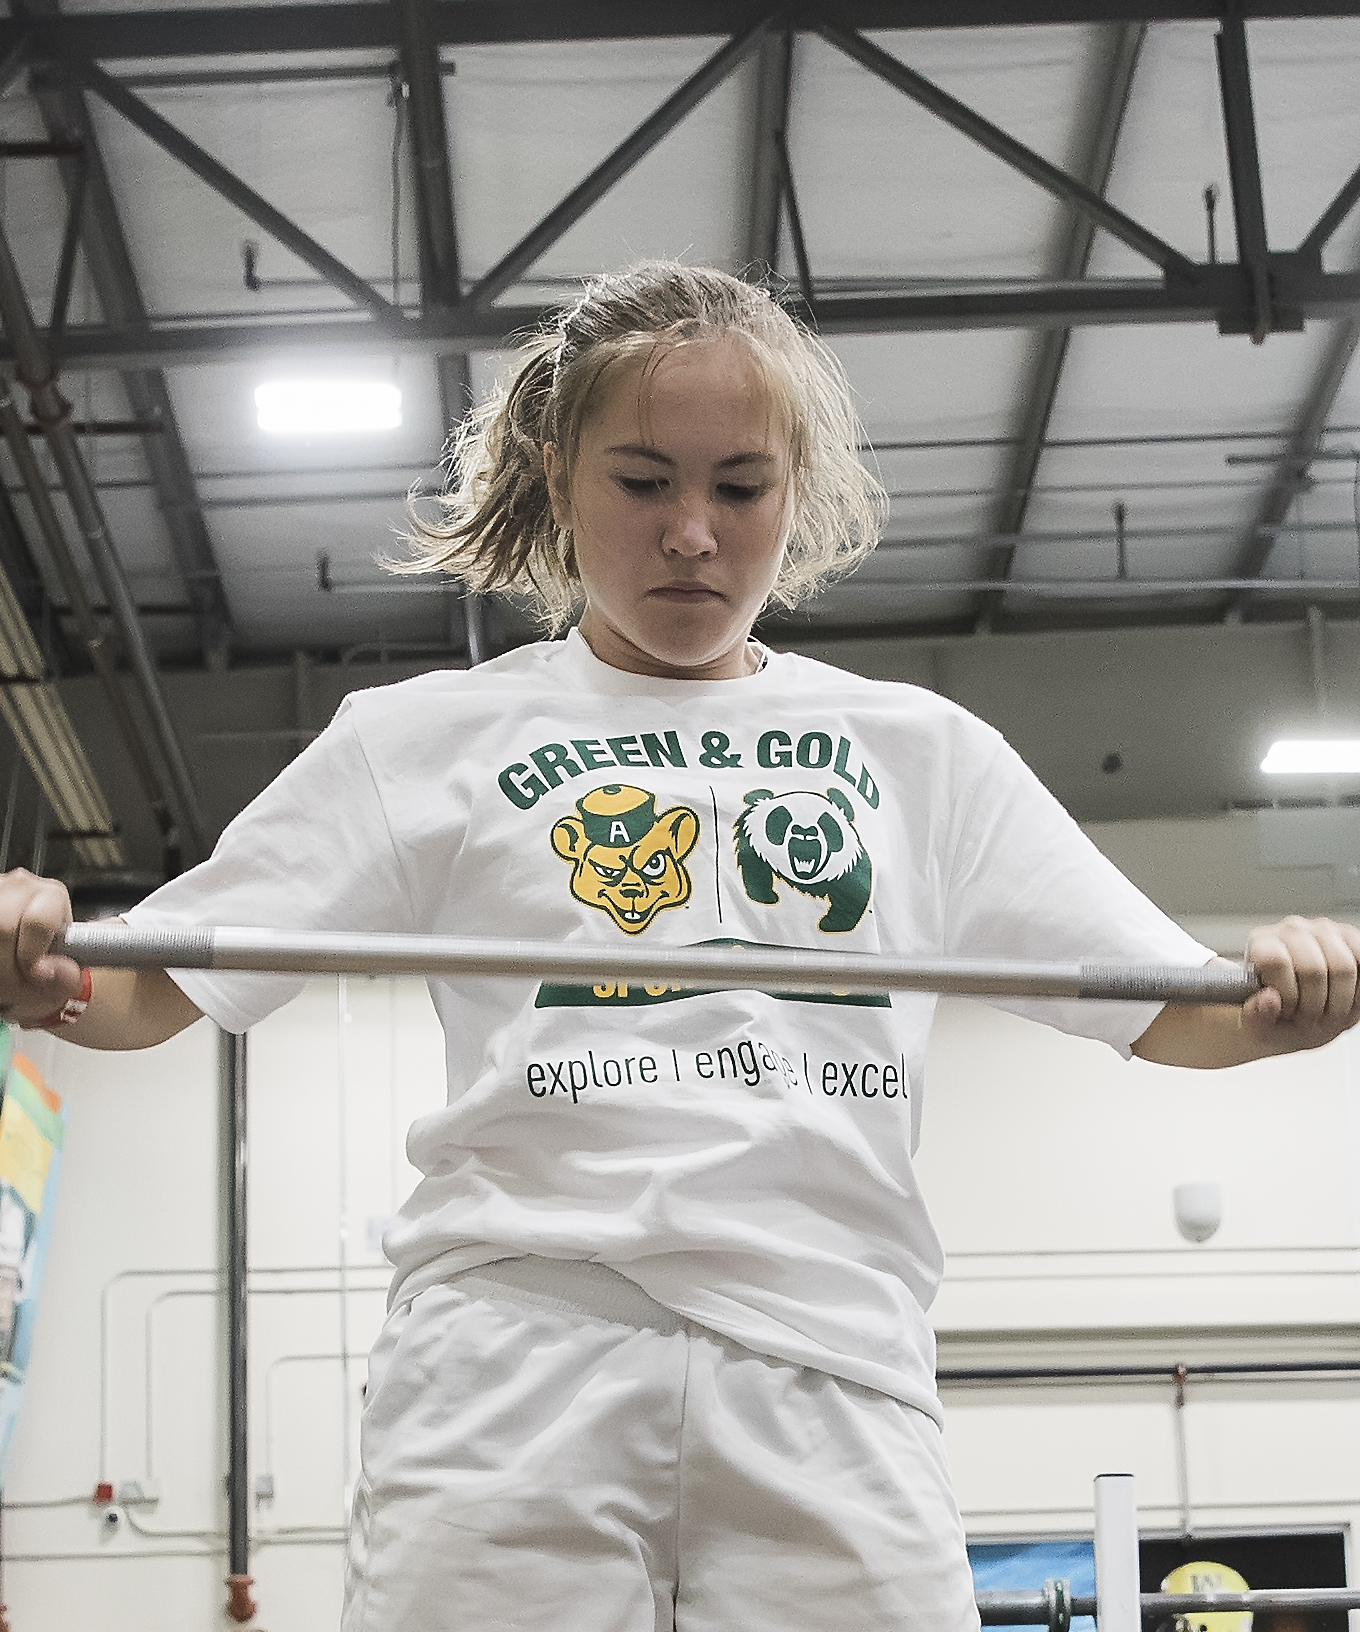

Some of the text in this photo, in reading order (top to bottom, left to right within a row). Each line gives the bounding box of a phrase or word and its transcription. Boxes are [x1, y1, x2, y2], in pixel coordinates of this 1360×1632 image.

[497, 729, 881, 810] GREEN & GOLD
[609, 819, 630, 844] A
[526, 1049, 659, 1104] explore
[821, 1053, 908, 1100] excel
